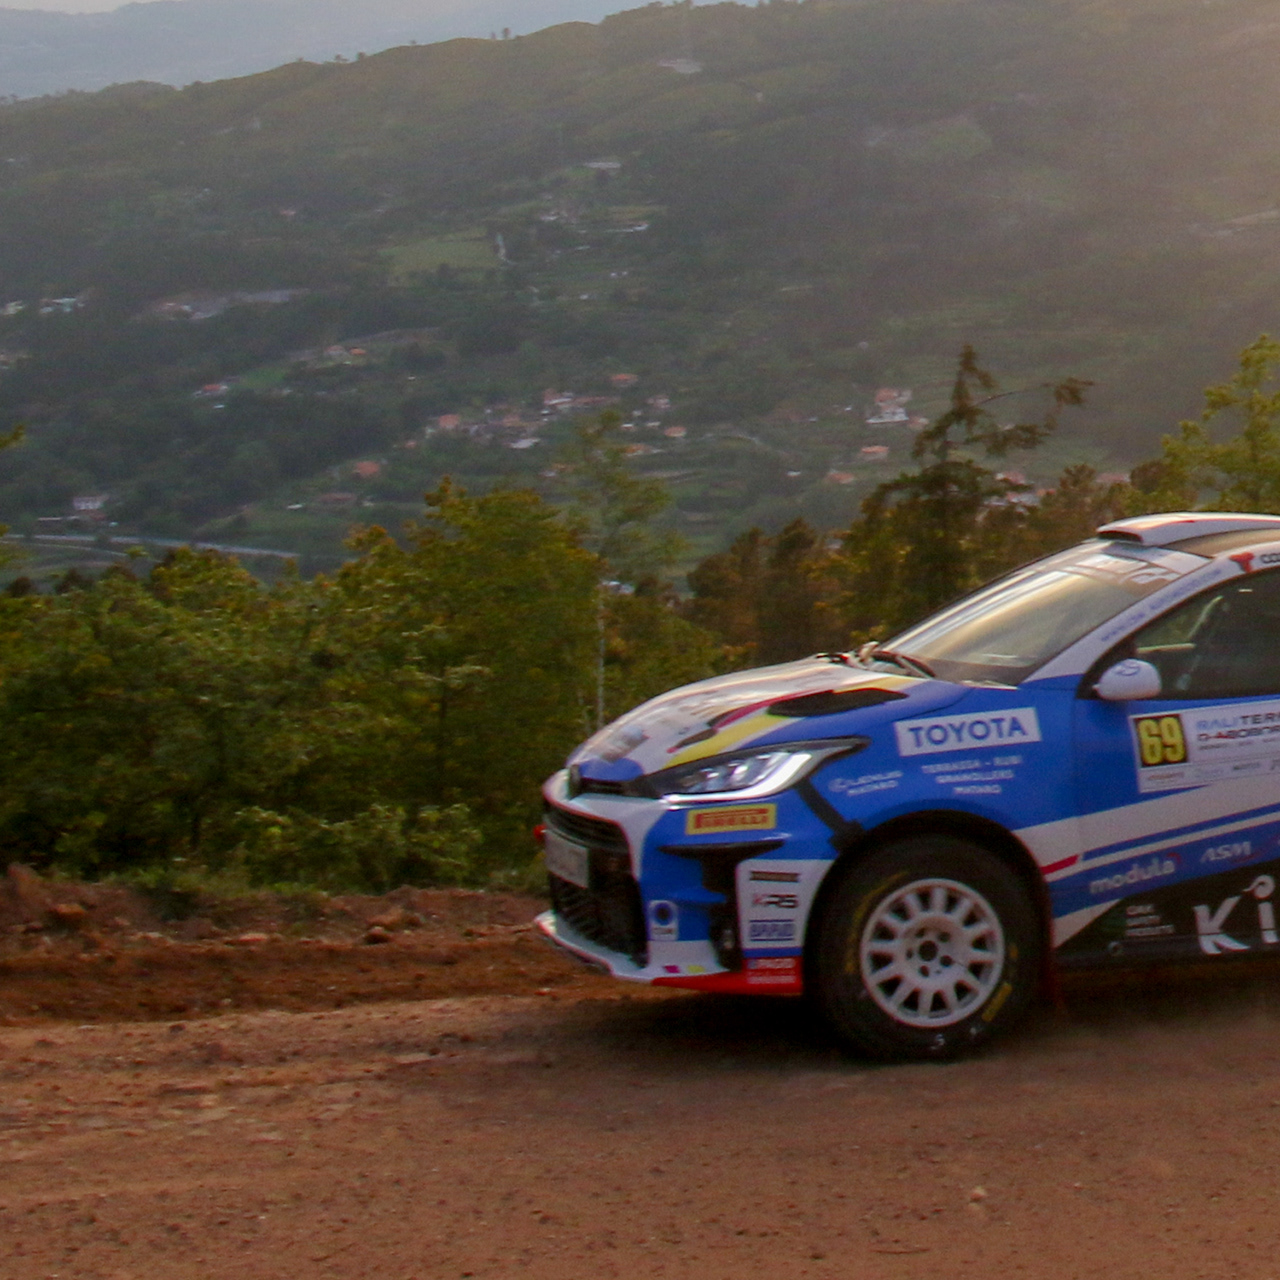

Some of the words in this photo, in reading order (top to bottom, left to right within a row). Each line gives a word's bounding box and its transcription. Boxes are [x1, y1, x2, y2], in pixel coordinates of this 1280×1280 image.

[908, 717, 1027, 748] TOYOTA
[1137, 717, 1187, 765] 69
[1200, 840, 1252, 864] ASM
[1090, 856, 1176, 894] modula
